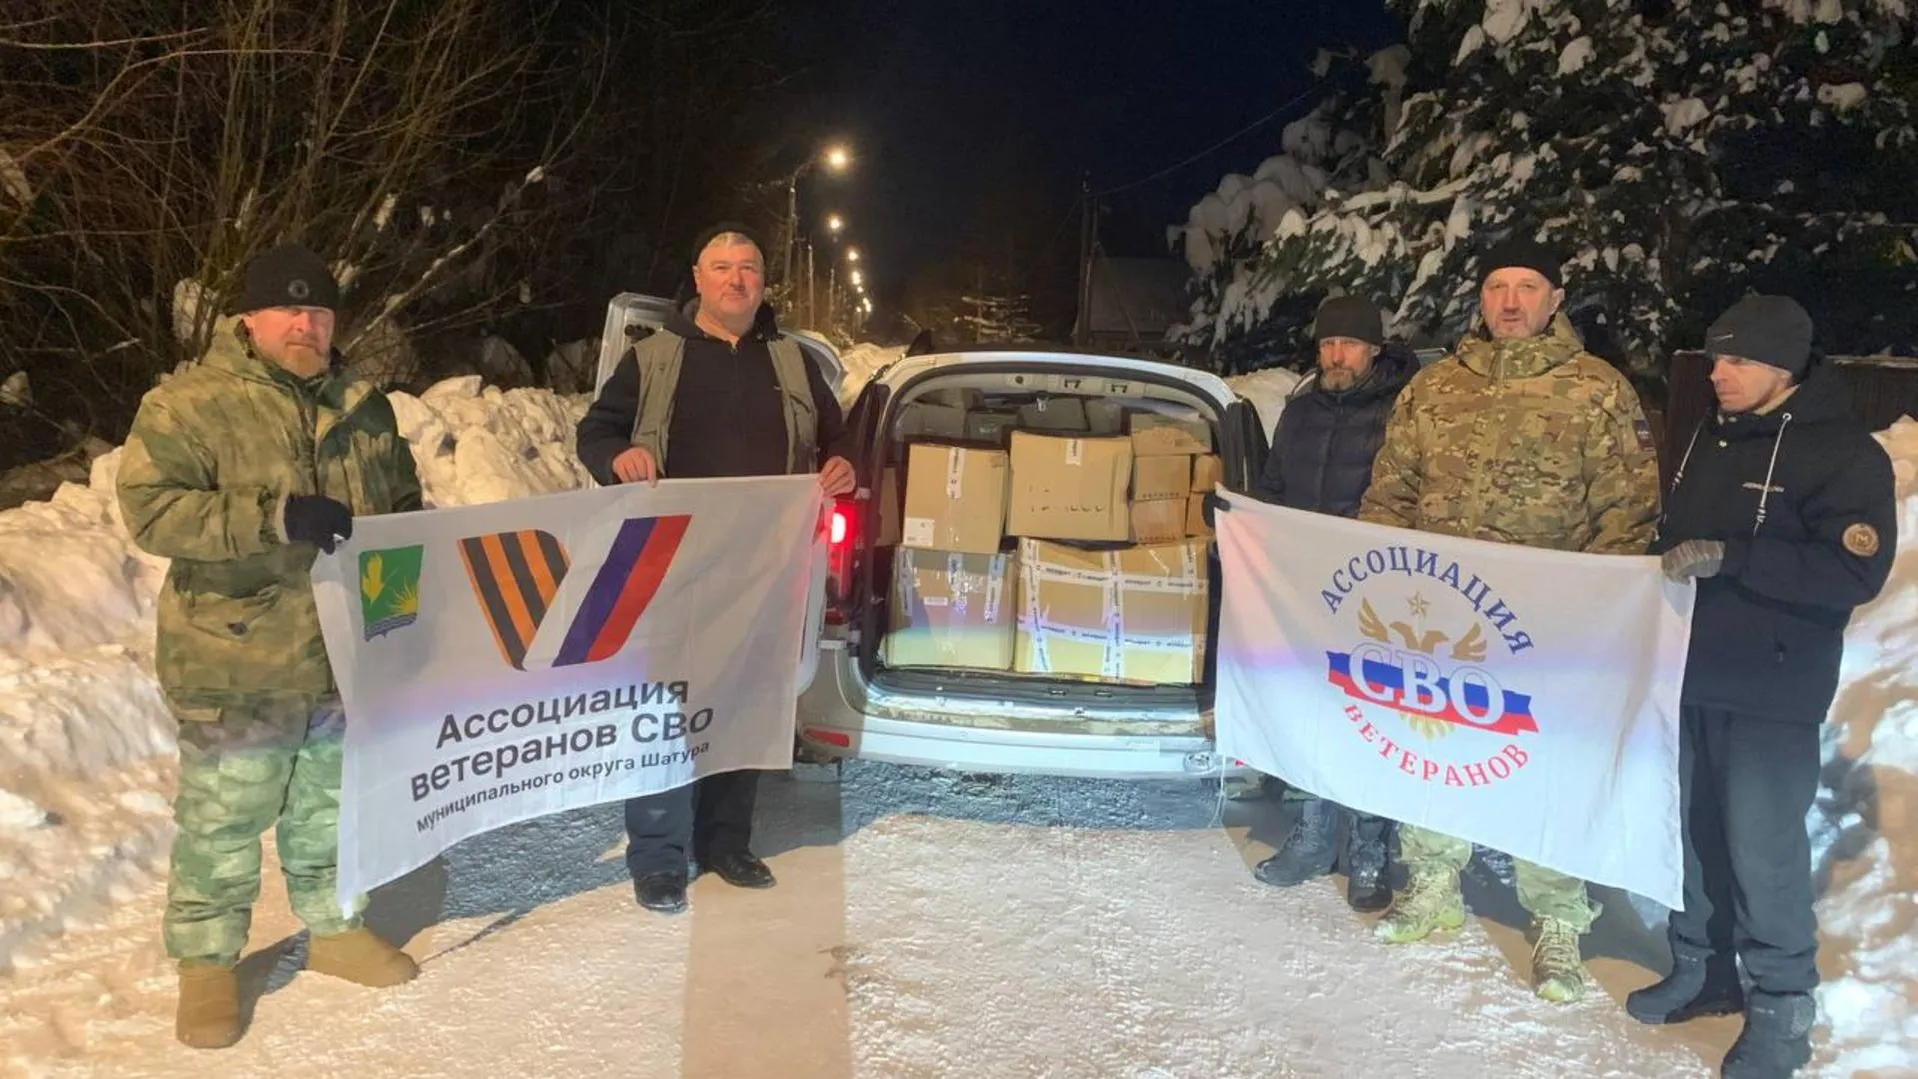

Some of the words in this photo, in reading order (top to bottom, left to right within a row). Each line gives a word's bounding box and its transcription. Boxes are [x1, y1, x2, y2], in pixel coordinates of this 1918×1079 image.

[1320, 546, 1534, 655] АССОЦИАЦИЯ
[436, 679, 689, 749] Ассоциация
[1348, 641, 1505, 726] СВО
[411, 722, 618, 803] ветеранов
[630, 706, 714, 742] СВО
[417, 769, 564, 833] муниципального
[569, 757, 635, 786] округа
[641, 741, 710, 770] Шатура
[1343, 702, 1530, 788] ВЕТЕРАНОВ
